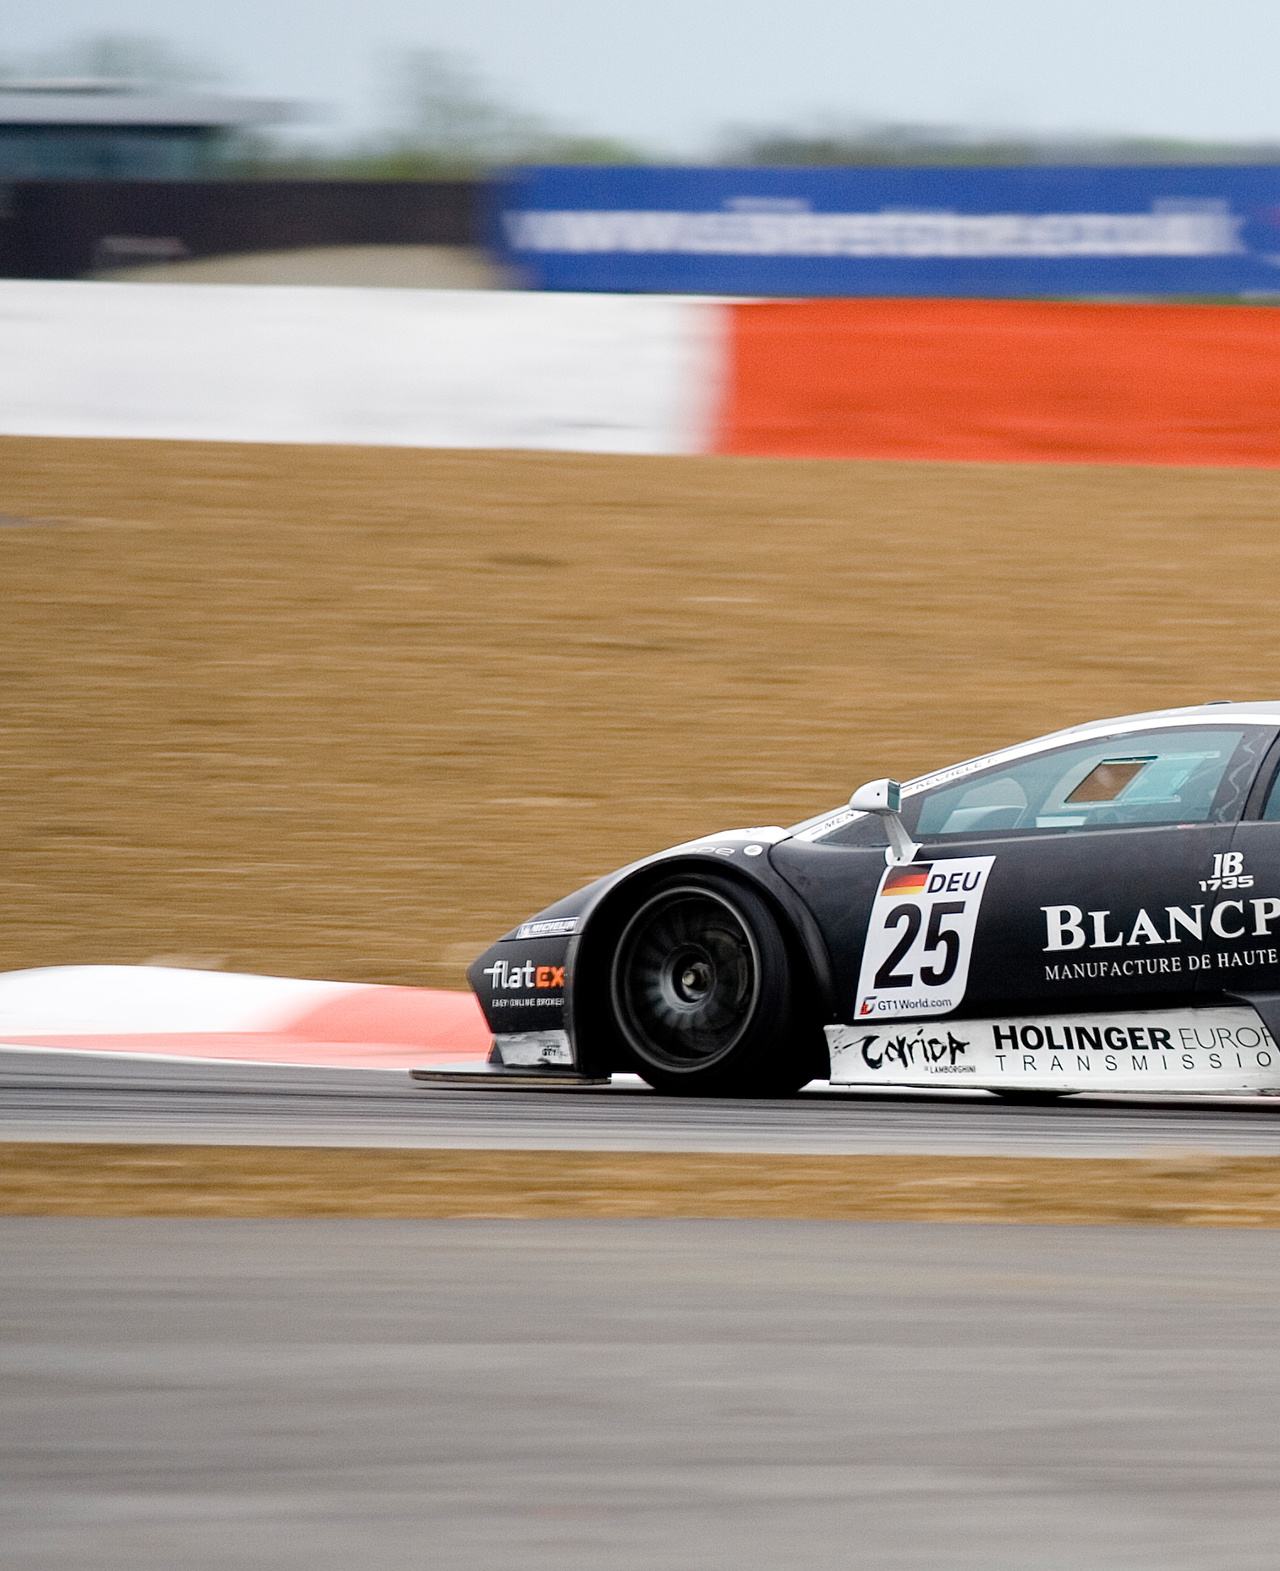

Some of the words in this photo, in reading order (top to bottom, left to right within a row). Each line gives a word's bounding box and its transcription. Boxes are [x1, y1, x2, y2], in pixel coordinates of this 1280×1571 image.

[927, 871, 982, 894] DEU
[1198, 875, 1255, 892] 1735
[873, 901, 966, 989] 25
[1045, 957, 1182, 980] MANUFACTURE
[1188, 954, 1211, 971] DE
[1218, 949, 1278, 968] HAUTE
[992, 1025, 1174, 1051] HOLINGER
[930, 1065, 977, 1075] LAMBORGHINI
[995, 1051, 1272, 1071] TRANSMISSIO
